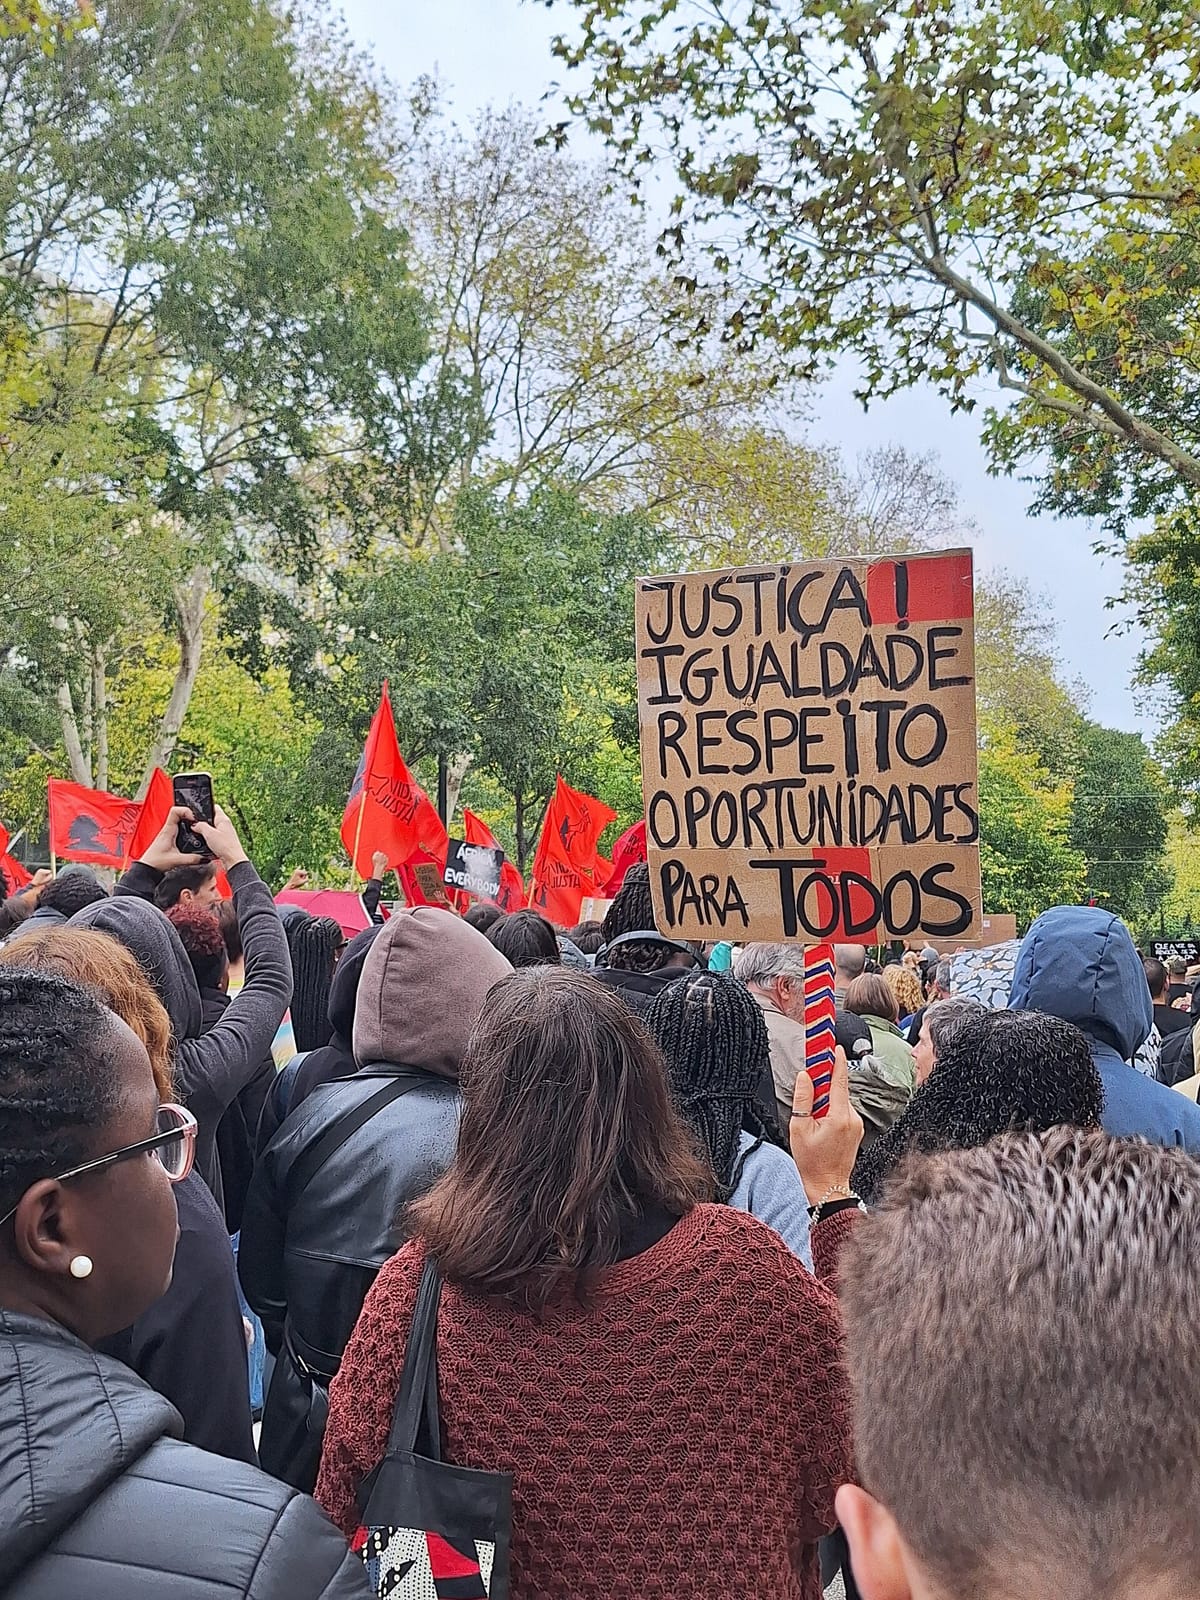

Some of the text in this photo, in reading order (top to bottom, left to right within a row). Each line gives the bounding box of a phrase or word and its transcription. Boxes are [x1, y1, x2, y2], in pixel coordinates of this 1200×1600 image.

[641, 627, 973, 705] IGUALDADE
[375, 793, 415, 826] JUSTA
[444, 867, 501, 897] EVERYBODY
[551, 873, 581, 889] JUSTA
[660, 860, 974, 938] PARA TODOS
